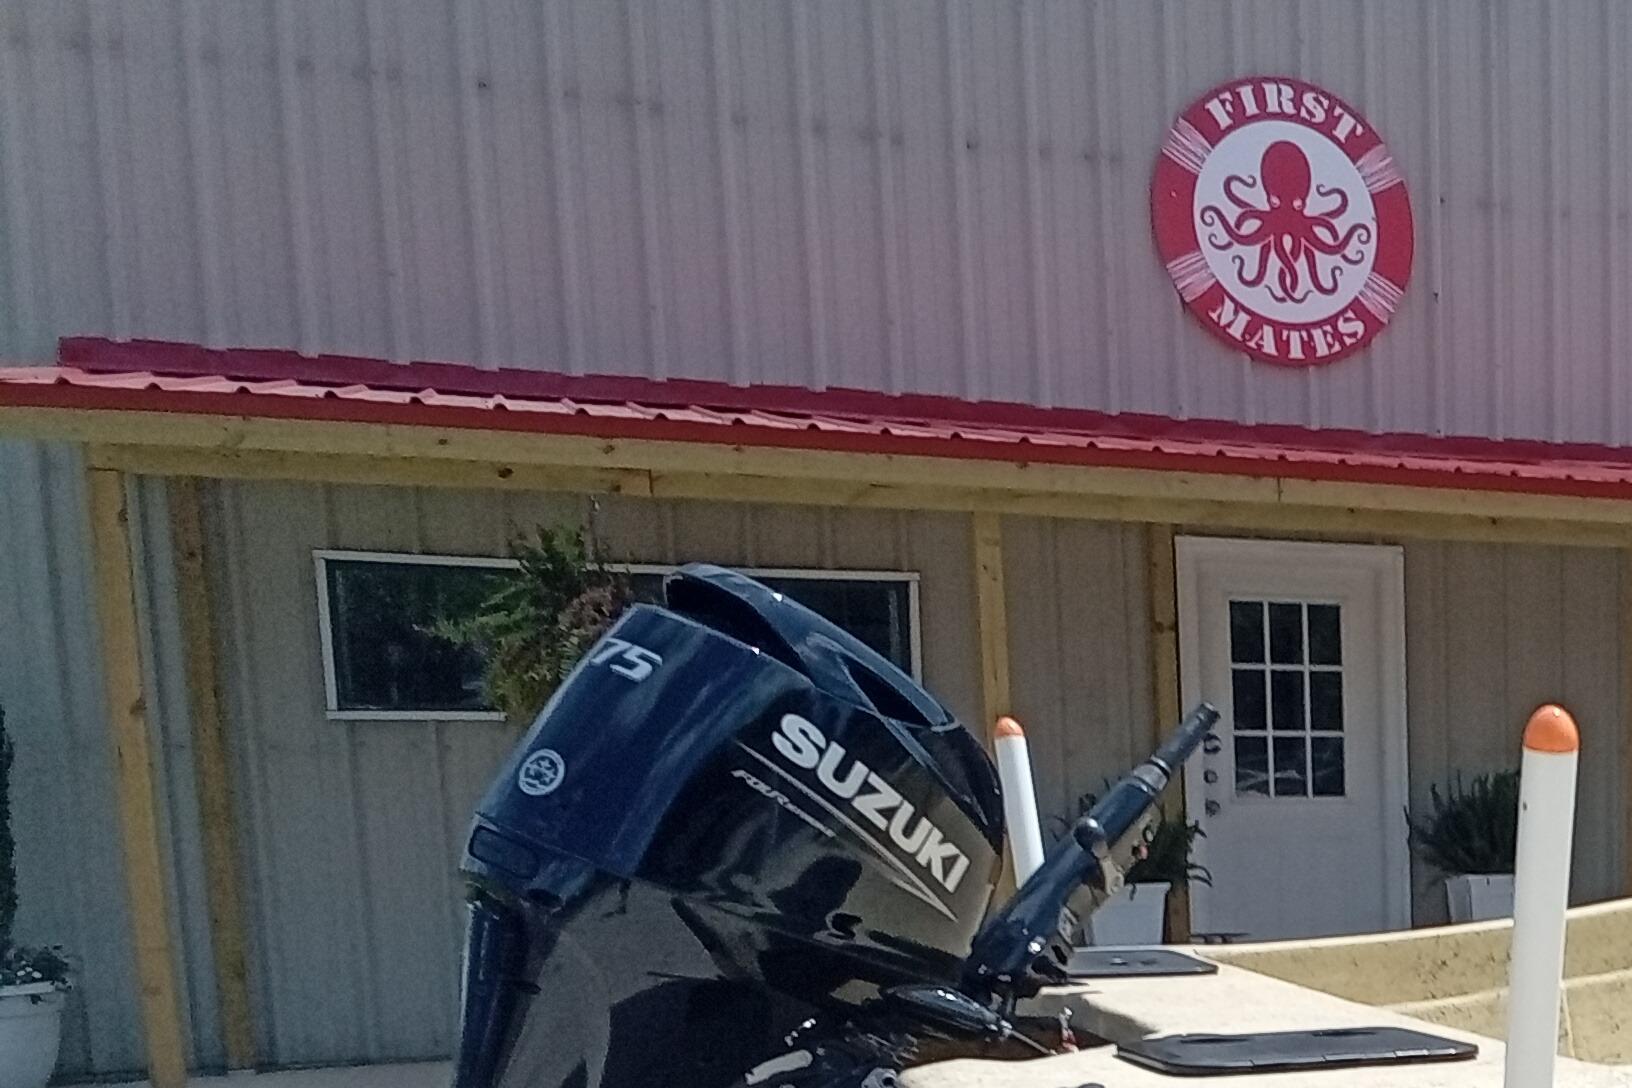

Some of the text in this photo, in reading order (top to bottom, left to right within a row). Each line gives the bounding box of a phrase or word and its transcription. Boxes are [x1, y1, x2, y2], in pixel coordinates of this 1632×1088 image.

[1204, 82, 1364, 144] FIRST
[1207, 295, 1366, 360] MATES
[590, 636, 663, 683] 75
[771, 713, 970, 894] SUZUKI
